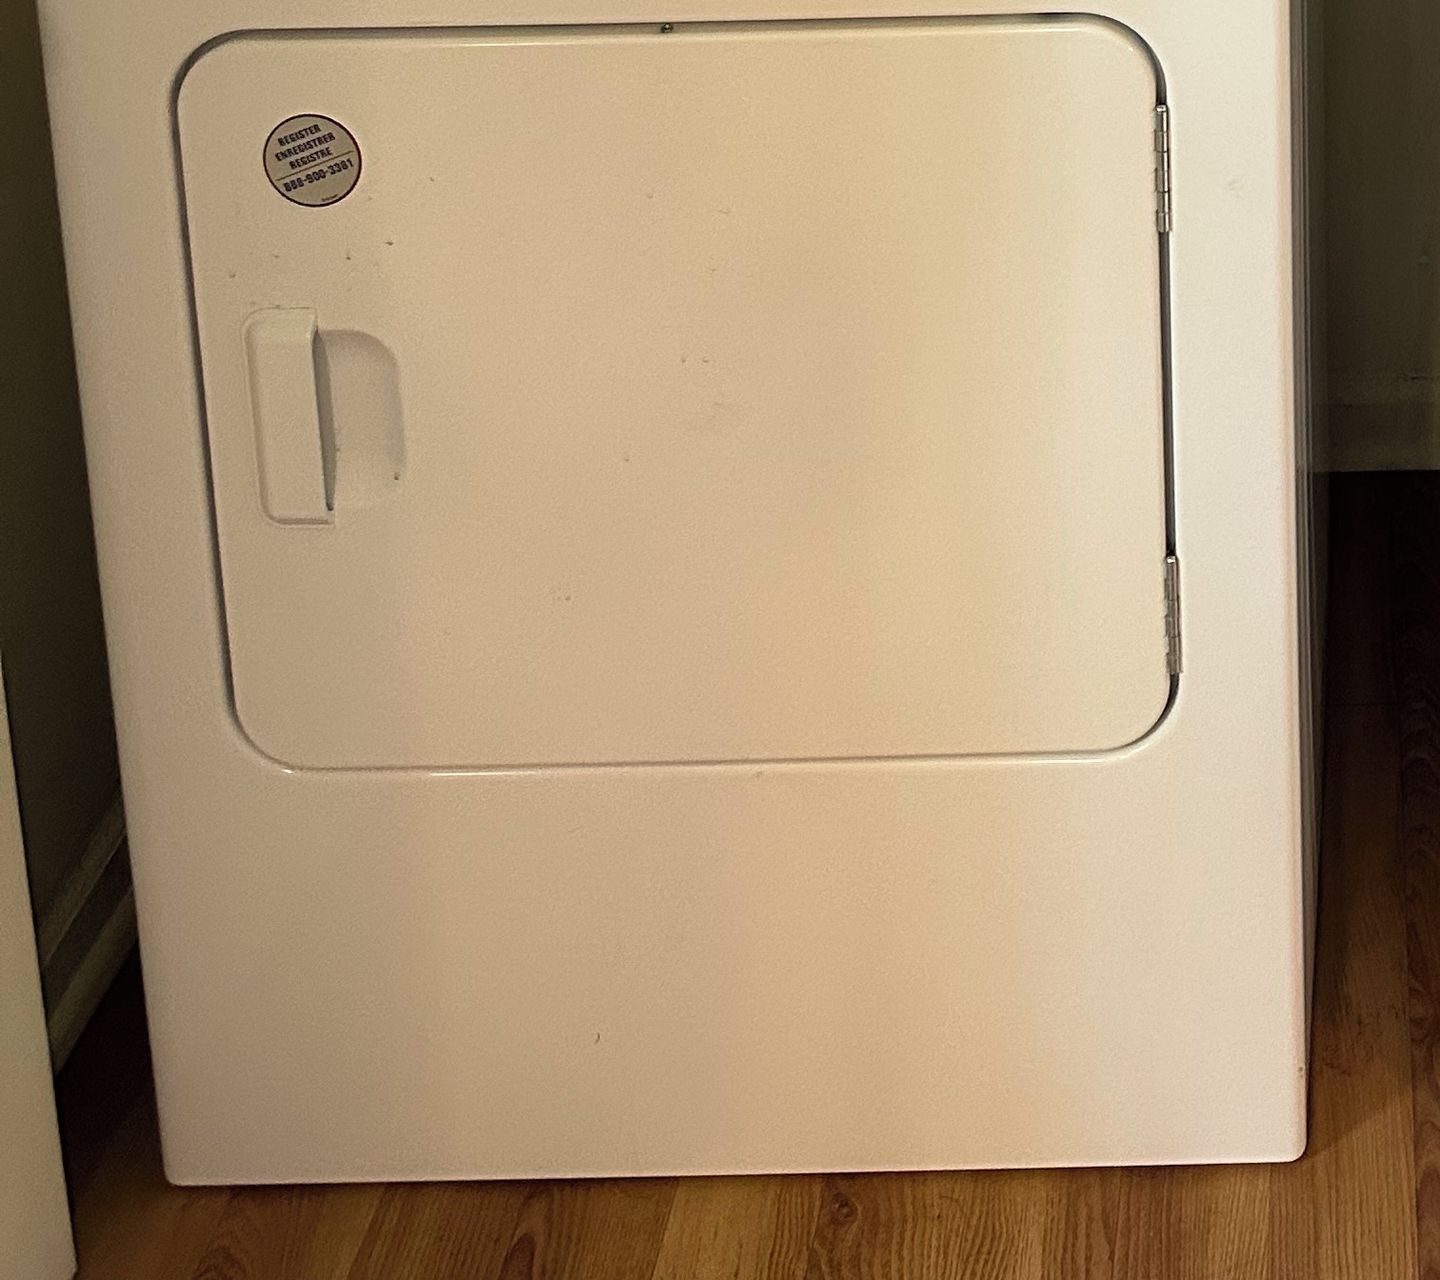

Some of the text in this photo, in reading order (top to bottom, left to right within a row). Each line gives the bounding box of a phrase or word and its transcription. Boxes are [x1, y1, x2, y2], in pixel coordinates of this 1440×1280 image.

[274, 131, 336, 161] ENREGISTRER
[277, 124, 321, 146] REGISTER
[288, 146, 333, 170] REGISTRE
